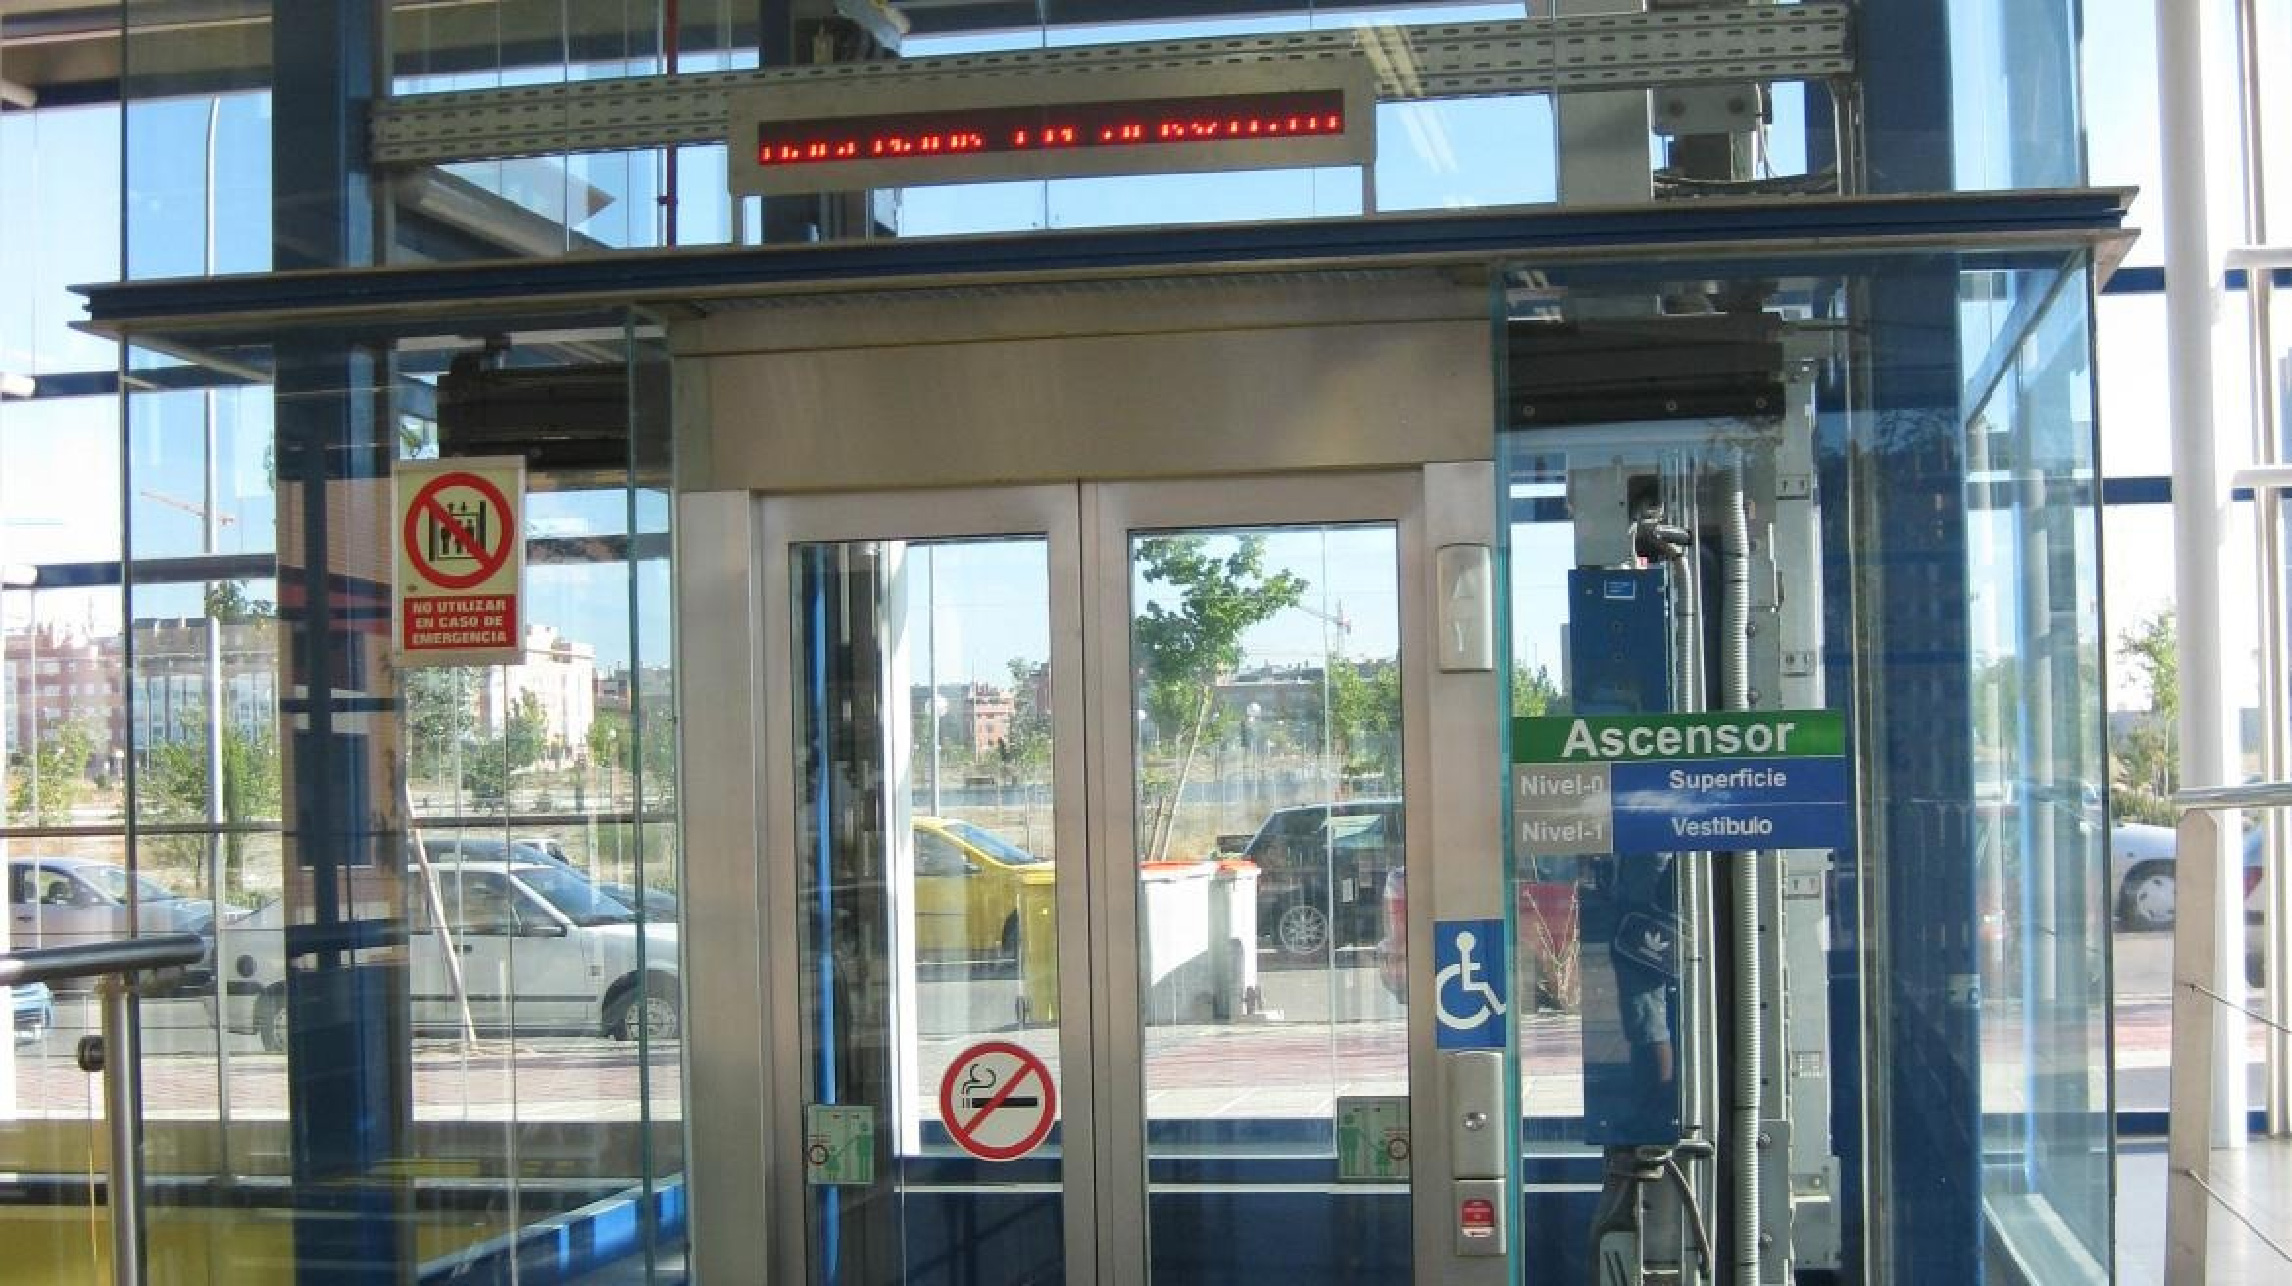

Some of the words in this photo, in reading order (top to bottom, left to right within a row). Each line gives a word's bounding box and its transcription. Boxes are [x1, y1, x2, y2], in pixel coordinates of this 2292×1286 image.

[413, 601, 432, 613] NO
[437, 600, 506, 613] UTILIZAR
[415, 617, 434, 628] EN
[438, 615, 479, 628] CASO
[483, 615, 503, 626] DE
[413, 630, 506, 643] EMERGENCIA
[1561, 719, 1796, 757] Ascensor
[1669, 768, 1787, 792] Superficie
[1522, 820, 1603, 842] Nivel-1
[1671, 816, 1773, 836] Vestibulo
